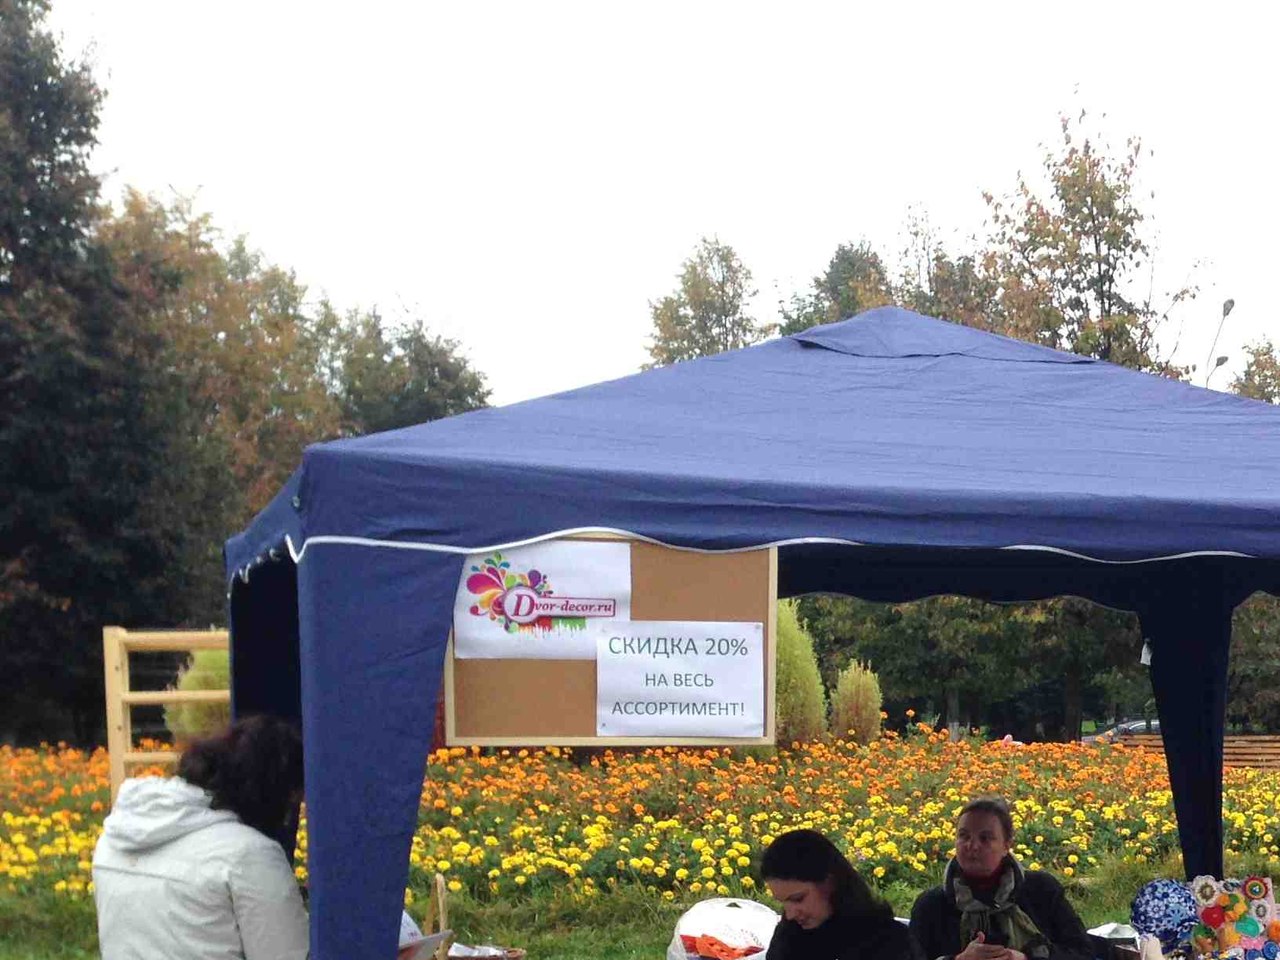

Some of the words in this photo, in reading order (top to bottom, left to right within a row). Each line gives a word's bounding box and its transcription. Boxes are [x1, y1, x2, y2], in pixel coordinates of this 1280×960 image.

[511, 593, 612, 617] Dvor-decor.ru
[608, 636, 698, 658] СКИДКА
[705, 638, 749, 656] 20%
[645, 673, 668, 687] НА
[673, 673, 714, 687] ВЕСЬ
[611, 701, 745, 716] АССОРТИМЕНТ!
